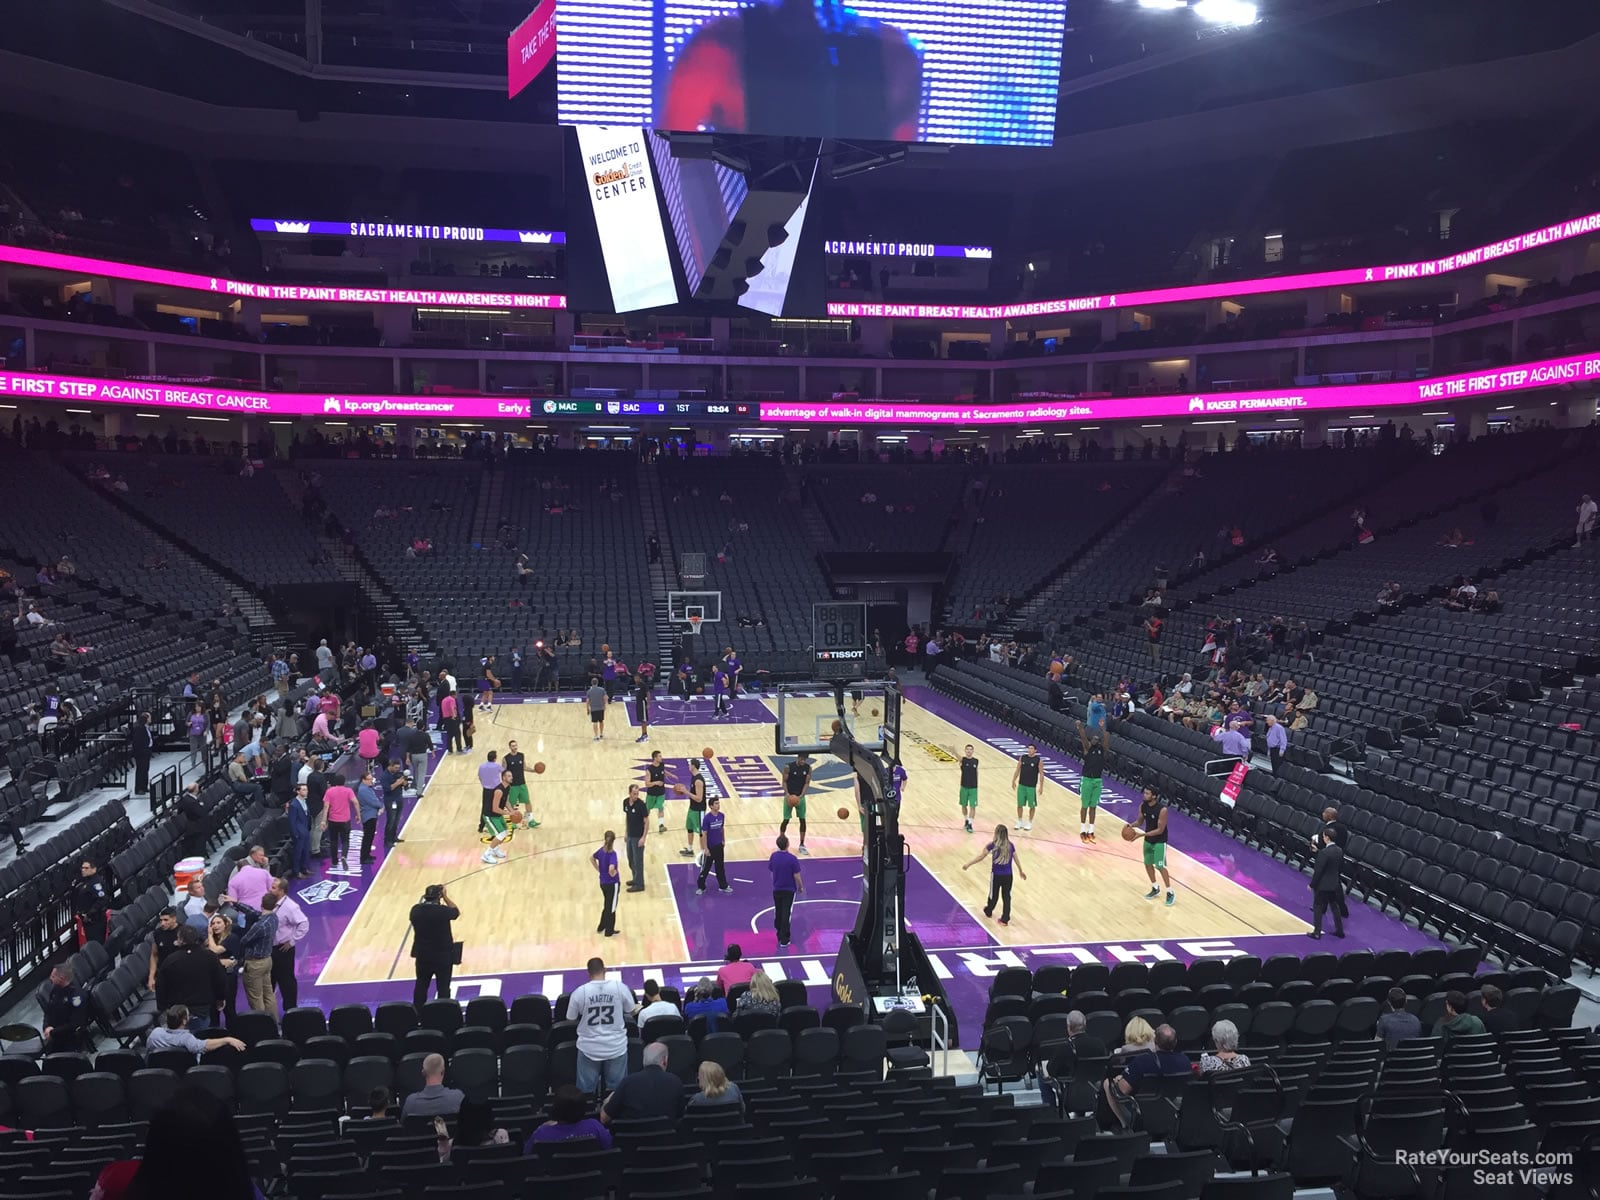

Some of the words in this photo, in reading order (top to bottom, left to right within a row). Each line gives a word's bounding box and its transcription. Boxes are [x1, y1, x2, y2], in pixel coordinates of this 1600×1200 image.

[521, 36, 537, 64] TAKE
[538, 20, 549, 47] THE
[589, 145, 628, 165] WELCOME
[628, 142, 640, 154] TO
[595, 176, 647, 201] CENTER
[350, 222, 440, 239] SACRAMENTO
[443, 226, 484, 241] PROUD
[824, 240, 895, 256] ACRAMENTO
[899, 243, 935, 257] PROUD
[1384, 265, 1418, 279] PINK
[1421, 262, 1436, 275] IN
[1436, 256, 1455, 273] THE
[1455, 249, 1484, 268] PAINT
[1483, 237, 1521, 260] BREAST
[1521, 225, 1562, 249] HEALTH
[226, 281, 255, 296] PINK
[257, 285, 269, 297] IN
[272, 286, 297, 299] THE
[299, 287, 337, 300] PAINT
[339, 289, 387, 302] BREAST
[389, 290, 436, 303] HEALTH
[438, 292, 512, 306] AWARENESS
[514, 294, 551, 307] NIGHT
[827, 303, 846, 315] NK
[847, 304, 859, 315] IN
[861, 304, 883, 316] THE
[884, 305, 917, 317] PAINT
[918, 306, 961, 318] BREAST
[961, 306, 1002, 318] HEALTH
[1003, 300, 1067, 317] AWARENESS
[1068, 296, 1101, 311] NIGHT
[1418, 382, 1444, 398] TAKE
[1445, 379, 1466, 394] THE
[1468, 374, 1498, 391] FIRST
[1499, 370, 1529, 387] STEP
[1529, 361, 1583, 382] AGAINST
[11, 377, 56, 395] FIRST
[59, 381, 97, 397] STEP
[100, 385, 162, 402] AGAINST
[165, 389, 214, 406] BREAST
[216, 393, 272, 410] CANCER.
[344, 398, 455, 413] kp.org/breastcancer
[498, 401, 524, 415] Early
[558, 402, 578, 411] MAC
[595, 403, 602, 411] 0
[622, 403, 640, 412] SAC
[658, 403, 665, 412] 0
[676, 404, 690, 412] 1ST
[767, 407, 816, 419] advantage
[818, 408, 829, 417] of
[830, 408, 863, 417] walk-in
[864, 408, 894, 419] digital
[895, 410, 959, 420] mammograms
[961, 410, 971, 419] at
[973, 409, 1024, 419] Sacramento
[1026, 406, 1067, 417] radiology
[1069, 405, 1093, 415] sites.
[1206, 399, 1237, 410] KAISER
[830, 650, 864, 658] TISSOT
[588, 993, 615, 1005] MARTIN
[587, 1005, 614, 1026] 23
